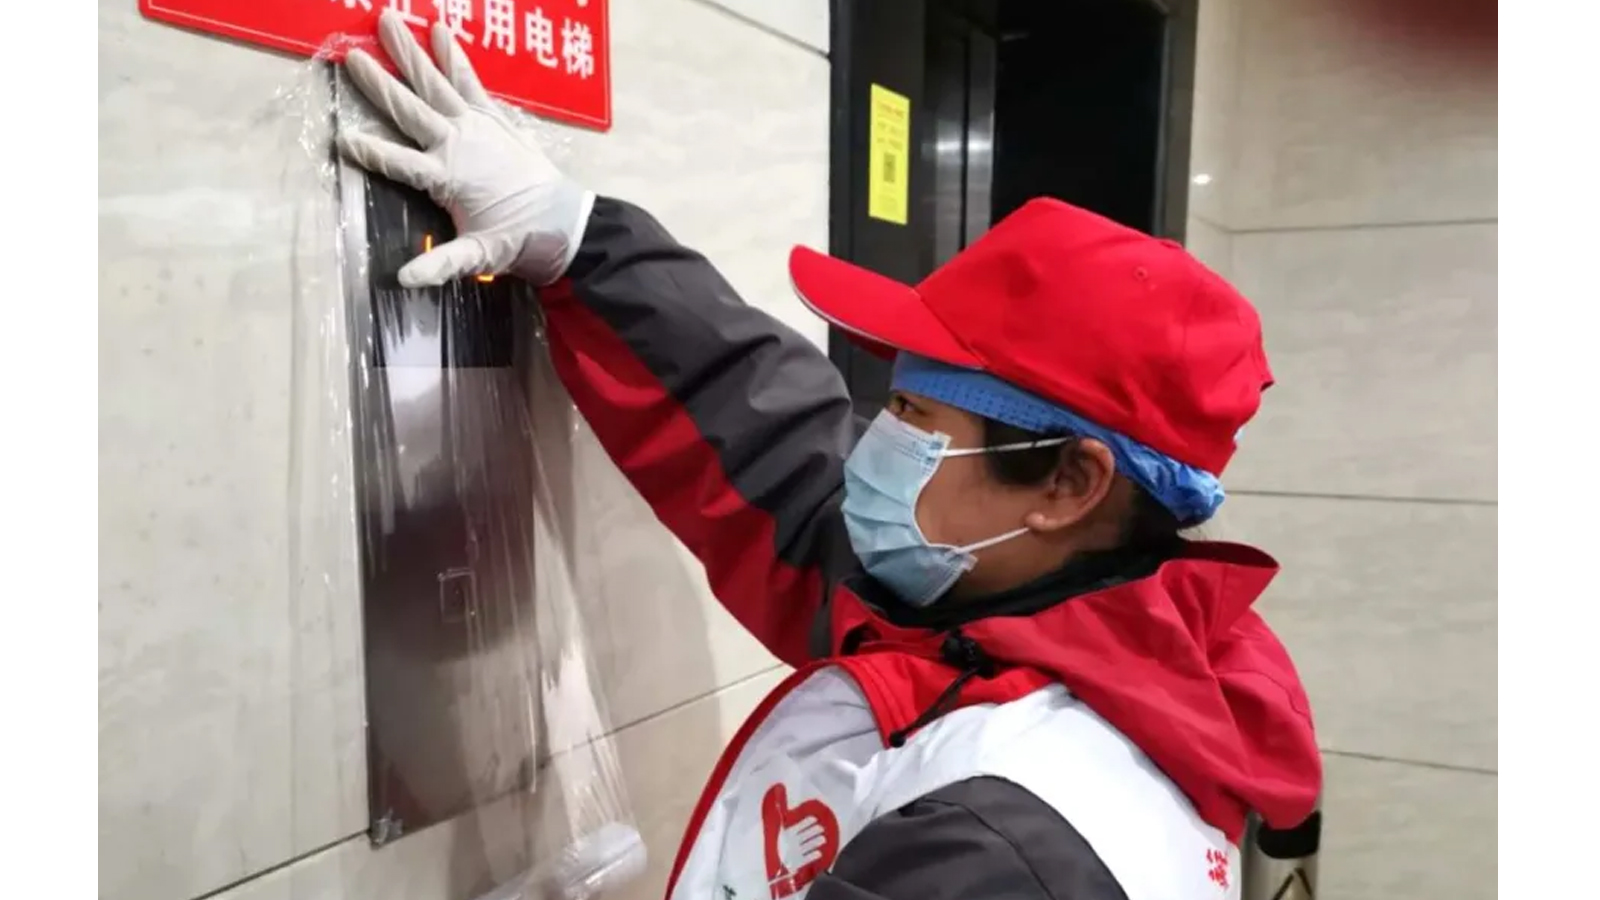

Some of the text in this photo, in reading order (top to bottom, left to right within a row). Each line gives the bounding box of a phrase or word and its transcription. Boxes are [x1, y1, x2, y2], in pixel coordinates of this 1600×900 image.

[329, 0, 595, 79] 止使用电梯
